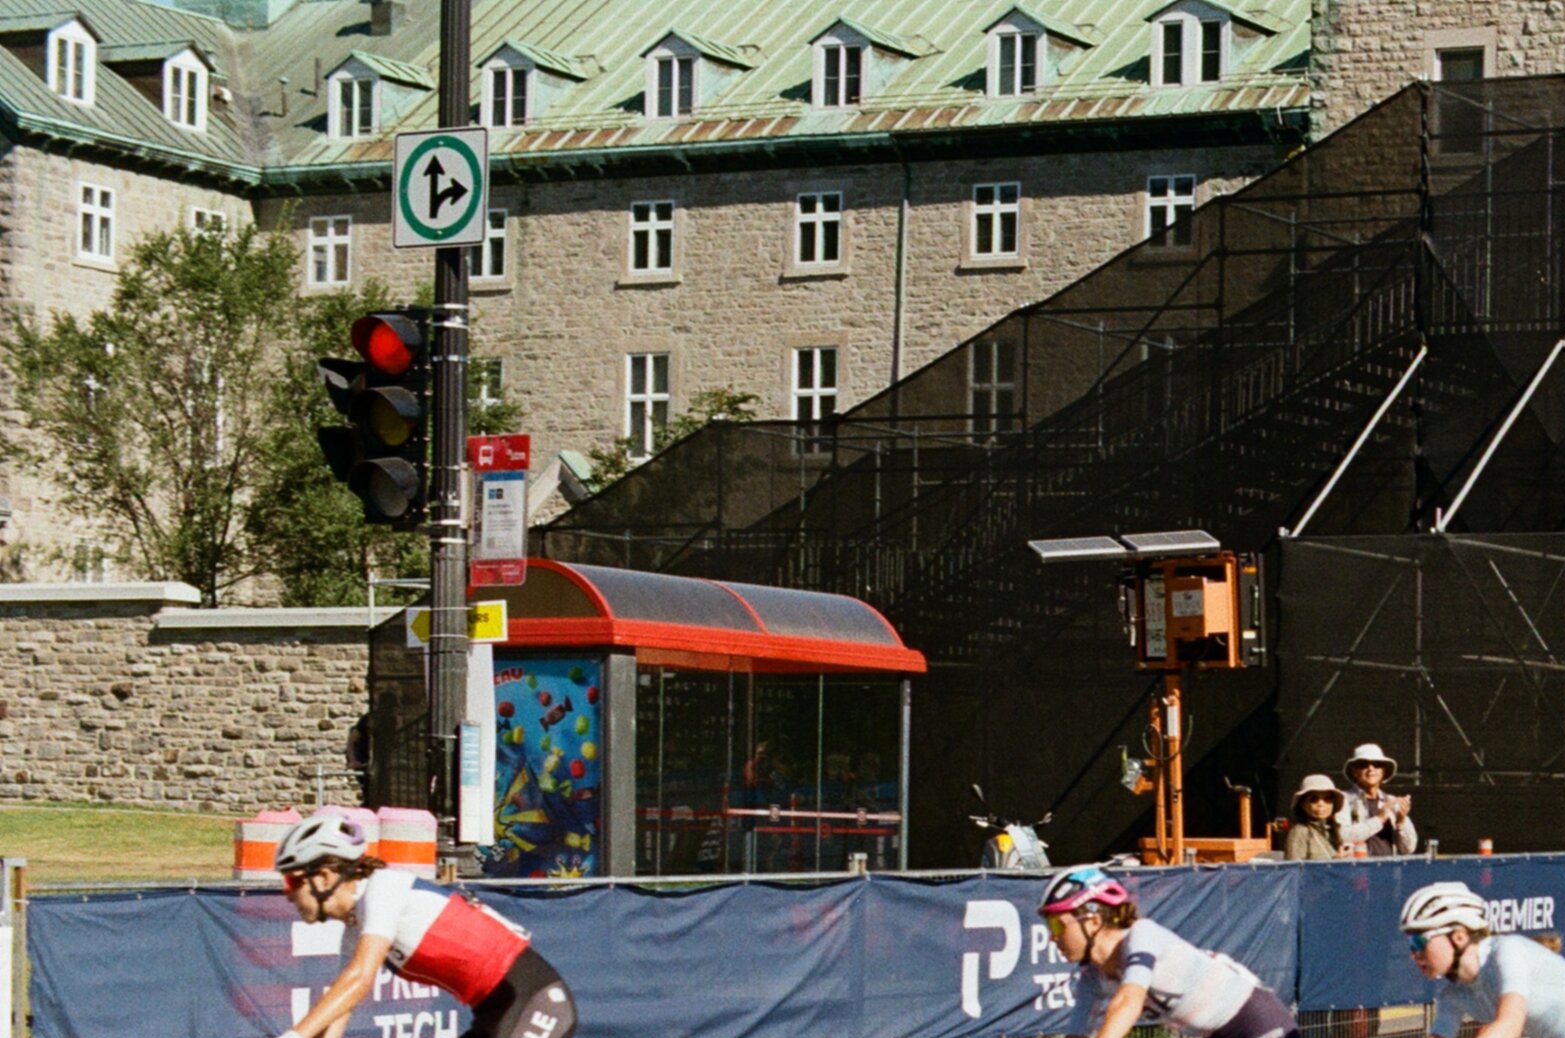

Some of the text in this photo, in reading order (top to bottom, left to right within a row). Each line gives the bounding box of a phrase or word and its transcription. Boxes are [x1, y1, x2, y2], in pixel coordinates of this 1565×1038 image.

[1483, 896, 1555, 932] PREMIER
[1031, 924, 1068, 964] PR
[1033, 971, 1081, 1010] TEC
